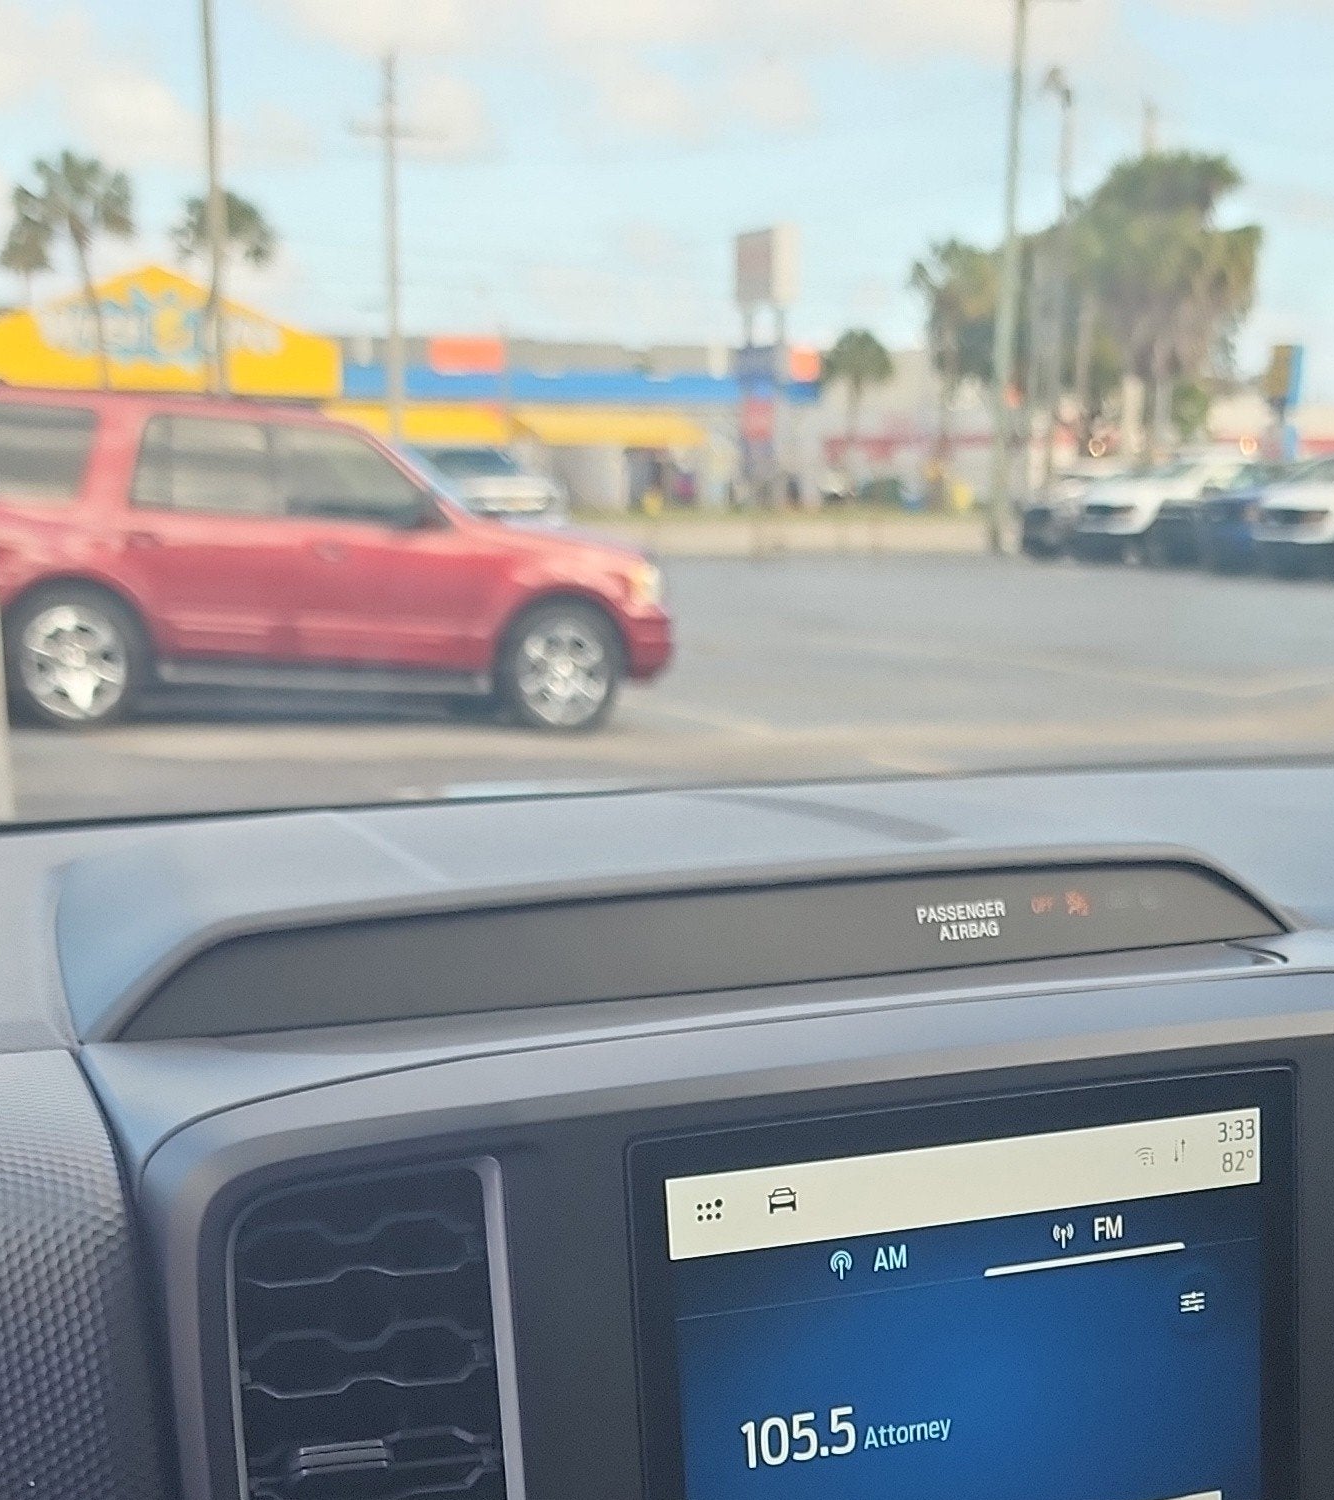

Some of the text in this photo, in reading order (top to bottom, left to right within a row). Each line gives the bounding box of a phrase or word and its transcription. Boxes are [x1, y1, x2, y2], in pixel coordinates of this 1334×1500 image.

[916, 900, 1006, 924] PASSENGER
[939, 920, 1000, 941] AIRBAG
[1217, 1119, 1255, 1143] 3:33
[1094, 1216, 1123, 1241] FM
[873, 1245, 907, 1271] AM
[740, 1405, 951, 1469] 105.5 Attorney
